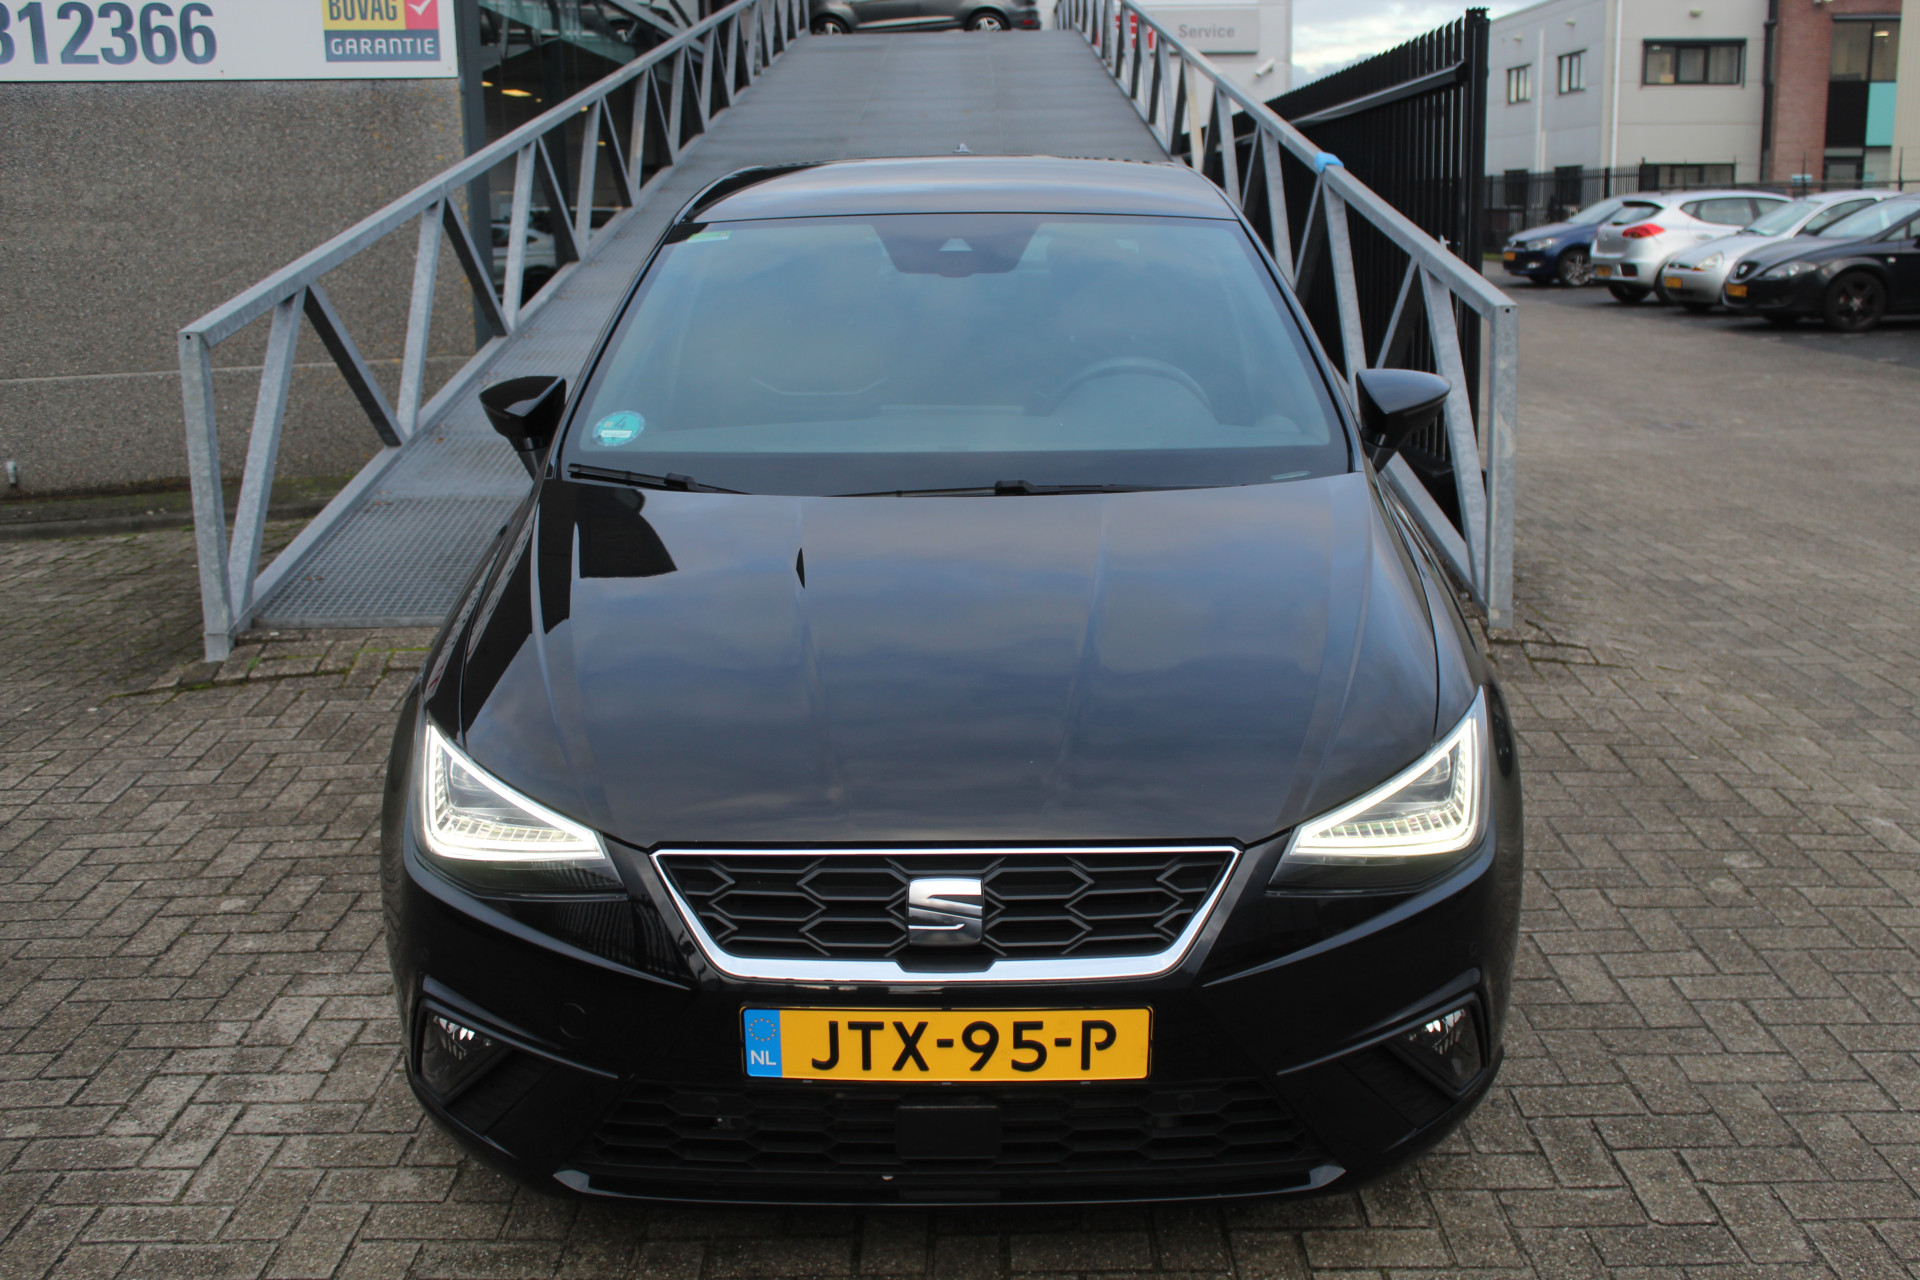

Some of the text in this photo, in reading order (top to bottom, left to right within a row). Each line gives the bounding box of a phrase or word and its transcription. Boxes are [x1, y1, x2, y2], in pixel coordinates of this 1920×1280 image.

[328, 0, 398, 20] BOVAG
[1178, 24, 1236, 39] Service
[331, 38, 435, 55] GARANTIE
[811, 1020, 1117, 1072] JTX-95-P
[750, 1050, 777, 1066] NL
